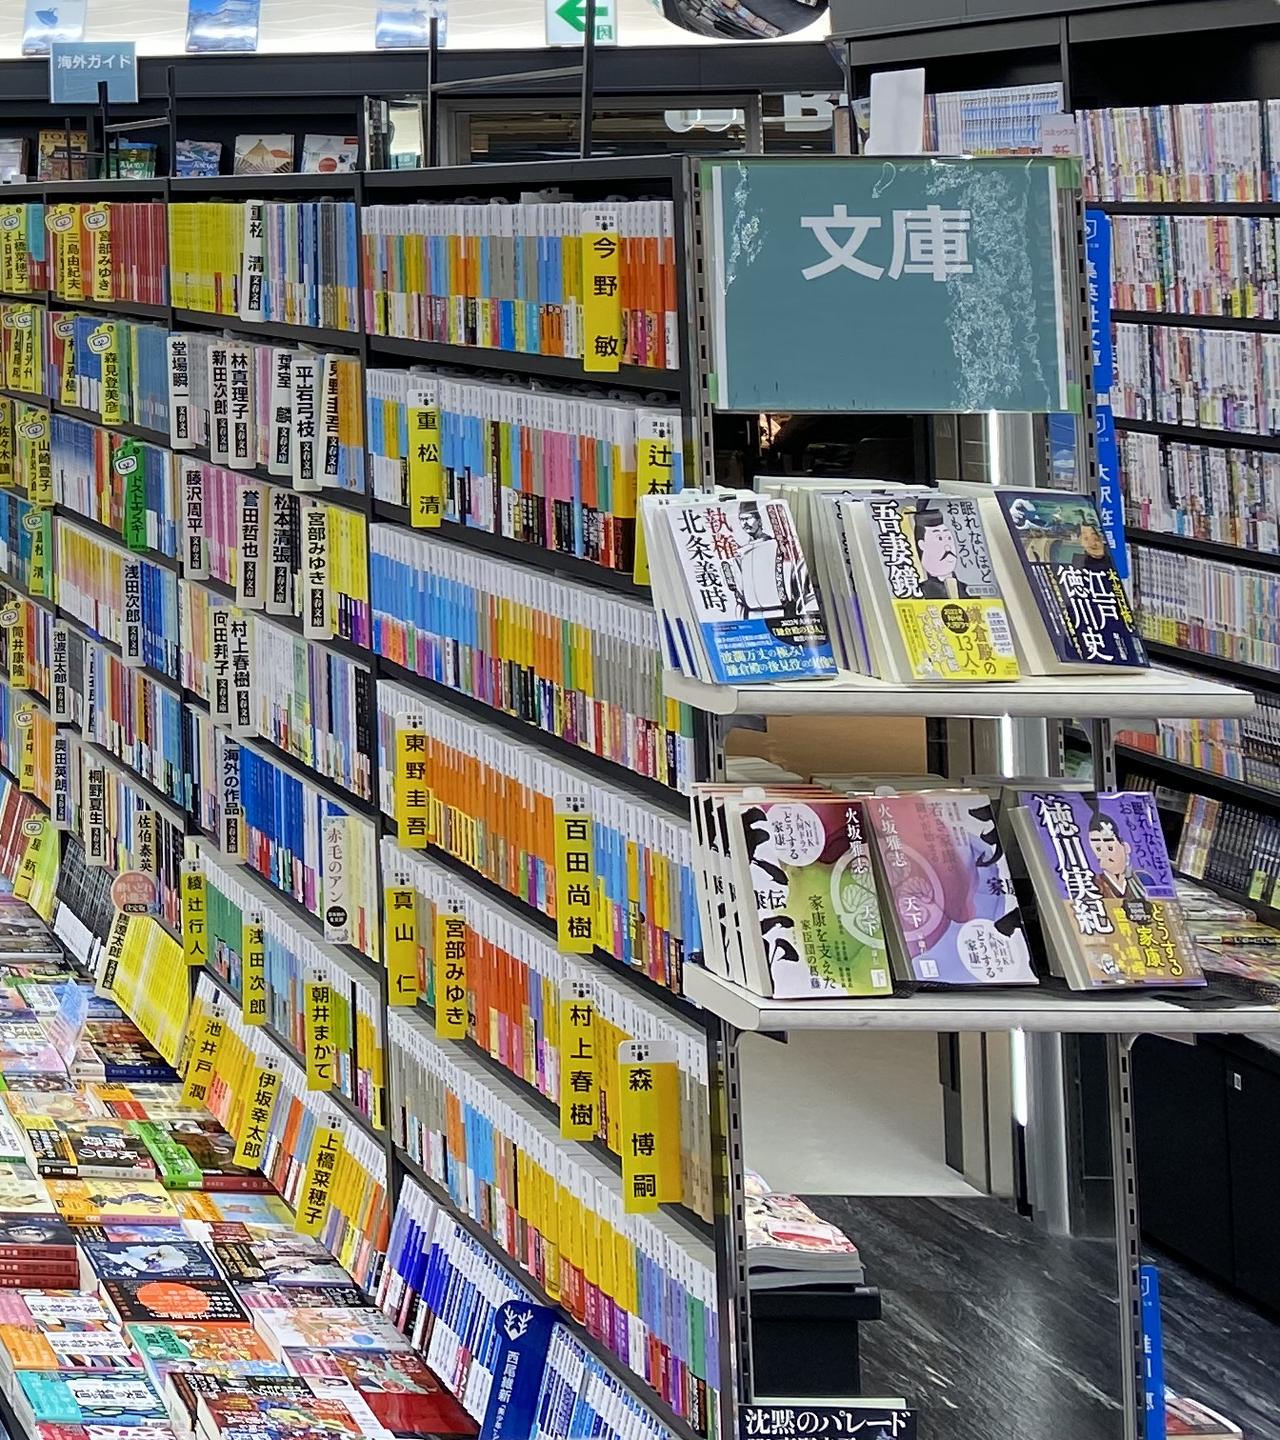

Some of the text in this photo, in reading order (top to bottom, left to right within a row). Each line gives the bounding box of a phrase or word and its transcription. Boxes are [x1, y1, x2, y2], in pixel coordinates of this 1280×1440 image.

[58, 55, 131, 70] 海外ガイド
[14, 232, 28, 284] 上橋菜穂子
[67, 232, 81, 290] 三島由紀夫
[98, 230, 113, 292] 宮部みゆき
[801, 204, 973, 282] 文庫
[593, 236, 619, 358] 今野敏
[105, 352, 120, 413] 森見登美彦
[172, 342, 189, 398] 堂場瞬一
[212, 350, 228, 415] 新田次郎
[231, 353, 249, 420] 林真理子
[296, 366, 315, 438] 平岩弓枝
[0, 425, 11, 476] 佐々木譲
[38, 440, 52, 492] 山崎豊子
[417, 410, 439, 515] 重松清
[131, 475, 144, 543] ドストエフスキー
[186, 470, 203, 533] 藤沢周平
[242, 490, 259, 558] 誉田哲也
[273, 493, 291, 563] 松本清張
[705, 506, 739, 560] 執権
[946, 501, 975, 570] おもしろい
[308, 513, 326, 585] 宮部みゆき
[679, 510, 728, 613] 北条義時
[870, 500, 924, 600] 吾妻鏡
[959, 501, 993, 584] 眠れないほど
[124, 564, 140, 623] 浅田次郎
[1057, 567, 1114, 661] 徳川史
[1081, 568, 1119, 630] 江戸
[12, 626, 26, 677] 筒井康隆
[54, 631, 67, 684] 池波正太郎
[213, 611, 229, 676] 向田邦子
[232, 620, 250, 688] 村上春樹
[54, 739, 67, 791] 奥田英朗
[88, 770, 103, 825] 桐野夏生
[224, 749, 240, 815] 海外の作品
[405, 734, 426, 836] 東野圭吾
[138, 814, 153, 873] 佐伯泰英
[327, 827, 343, 904] 赤毛のアン
[845, 807, 870, 873] 火坂雅志
[878, 803, 907, 868] 火坂雅志
[1032, 794, 1115, 935] 徳川実紀
[564, 818, 592, 940] 百田尚樹
[903, 897, 923, 928] 天下
[187, 875, 204, 955] 綾辻行人
[393, 891, 416, 993] 真山仁
[807, 894, 836, 990] 家康を支えた
[860, 905, 881, 937] 天下
[1151, 903, 1184, 976] どうする
[249, 928, 266, 1015] 浅田次郎
[444, 919, 466, 1026] 宮部みゆき
[800, 919, 821, 990] 家臣団の葛藤
[189, 1019, 222, 1101] 池井戸潤
[311, 986, 330, 1080] 朝井まかて
[569, 1004, 593, 1127] 村上春樹
[242, 1071, 277, 1160] 伊坂幸太郎
[628, 1068, 657, 1199] 森博嗣
[306, 1134, 338, 1225] 上橋菜穂子
[498, 1349, 522, 1402] 西尾維新
[744, 1408, 911, 1436] 沈黙のパレード
